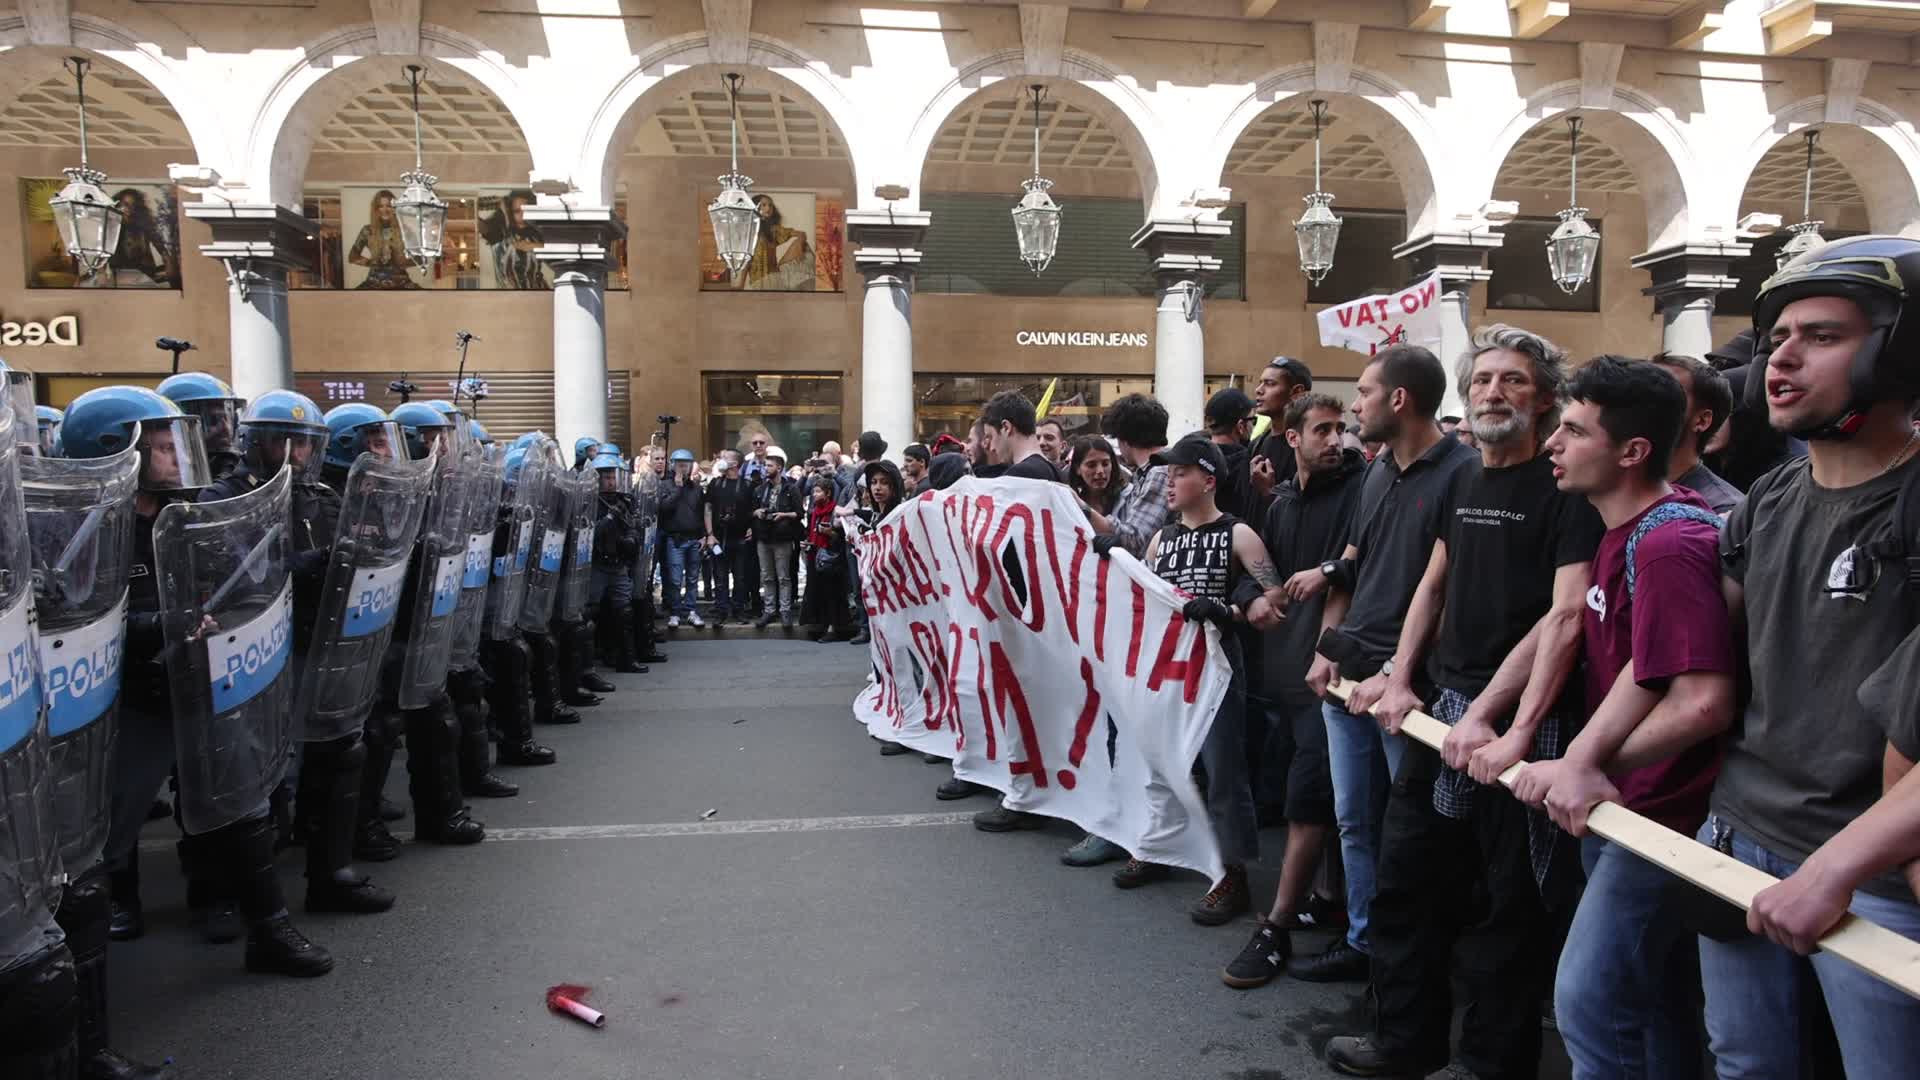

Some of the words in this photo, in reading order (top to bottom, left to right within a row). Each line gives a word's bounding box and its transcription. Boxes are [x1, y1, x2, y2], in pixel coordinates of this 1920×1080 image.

[1016, 331, 1066, 346] CALVIN
[1067, 332, 1104, 346] KLEIN
[1105, 333, 1148, 347] JEANS
[323, 381, 365, 400] TIM
[1153, 549, 1229, 573] YOUTH
